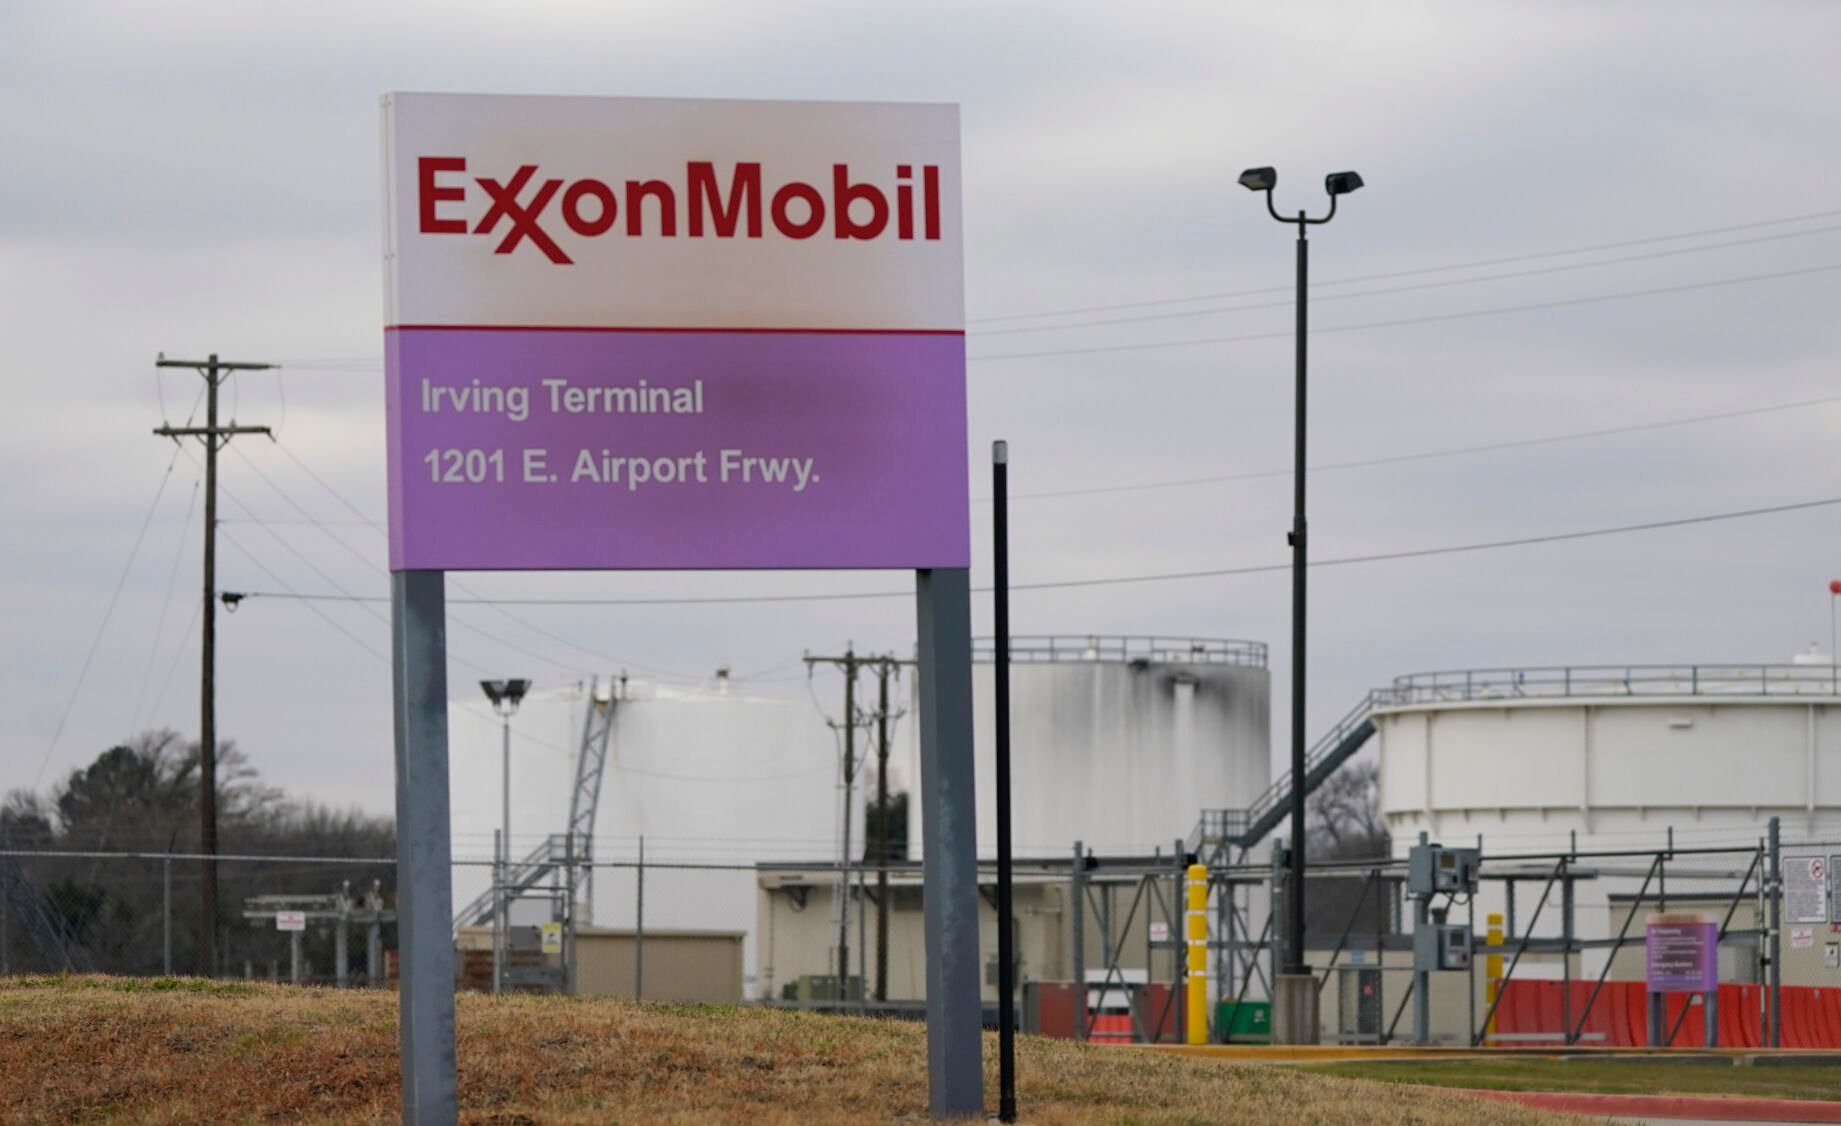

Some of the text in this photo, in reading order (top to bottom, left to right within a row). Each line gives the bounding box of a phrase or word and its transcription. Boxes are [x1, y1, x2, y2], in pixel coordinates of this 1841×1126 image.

[418, 156, 941, 265] ExxonMobil
[422, 379, 703, 421] Irving Terminal
[424, 448, 820, 492] 1201 E. Airport Frwy.
